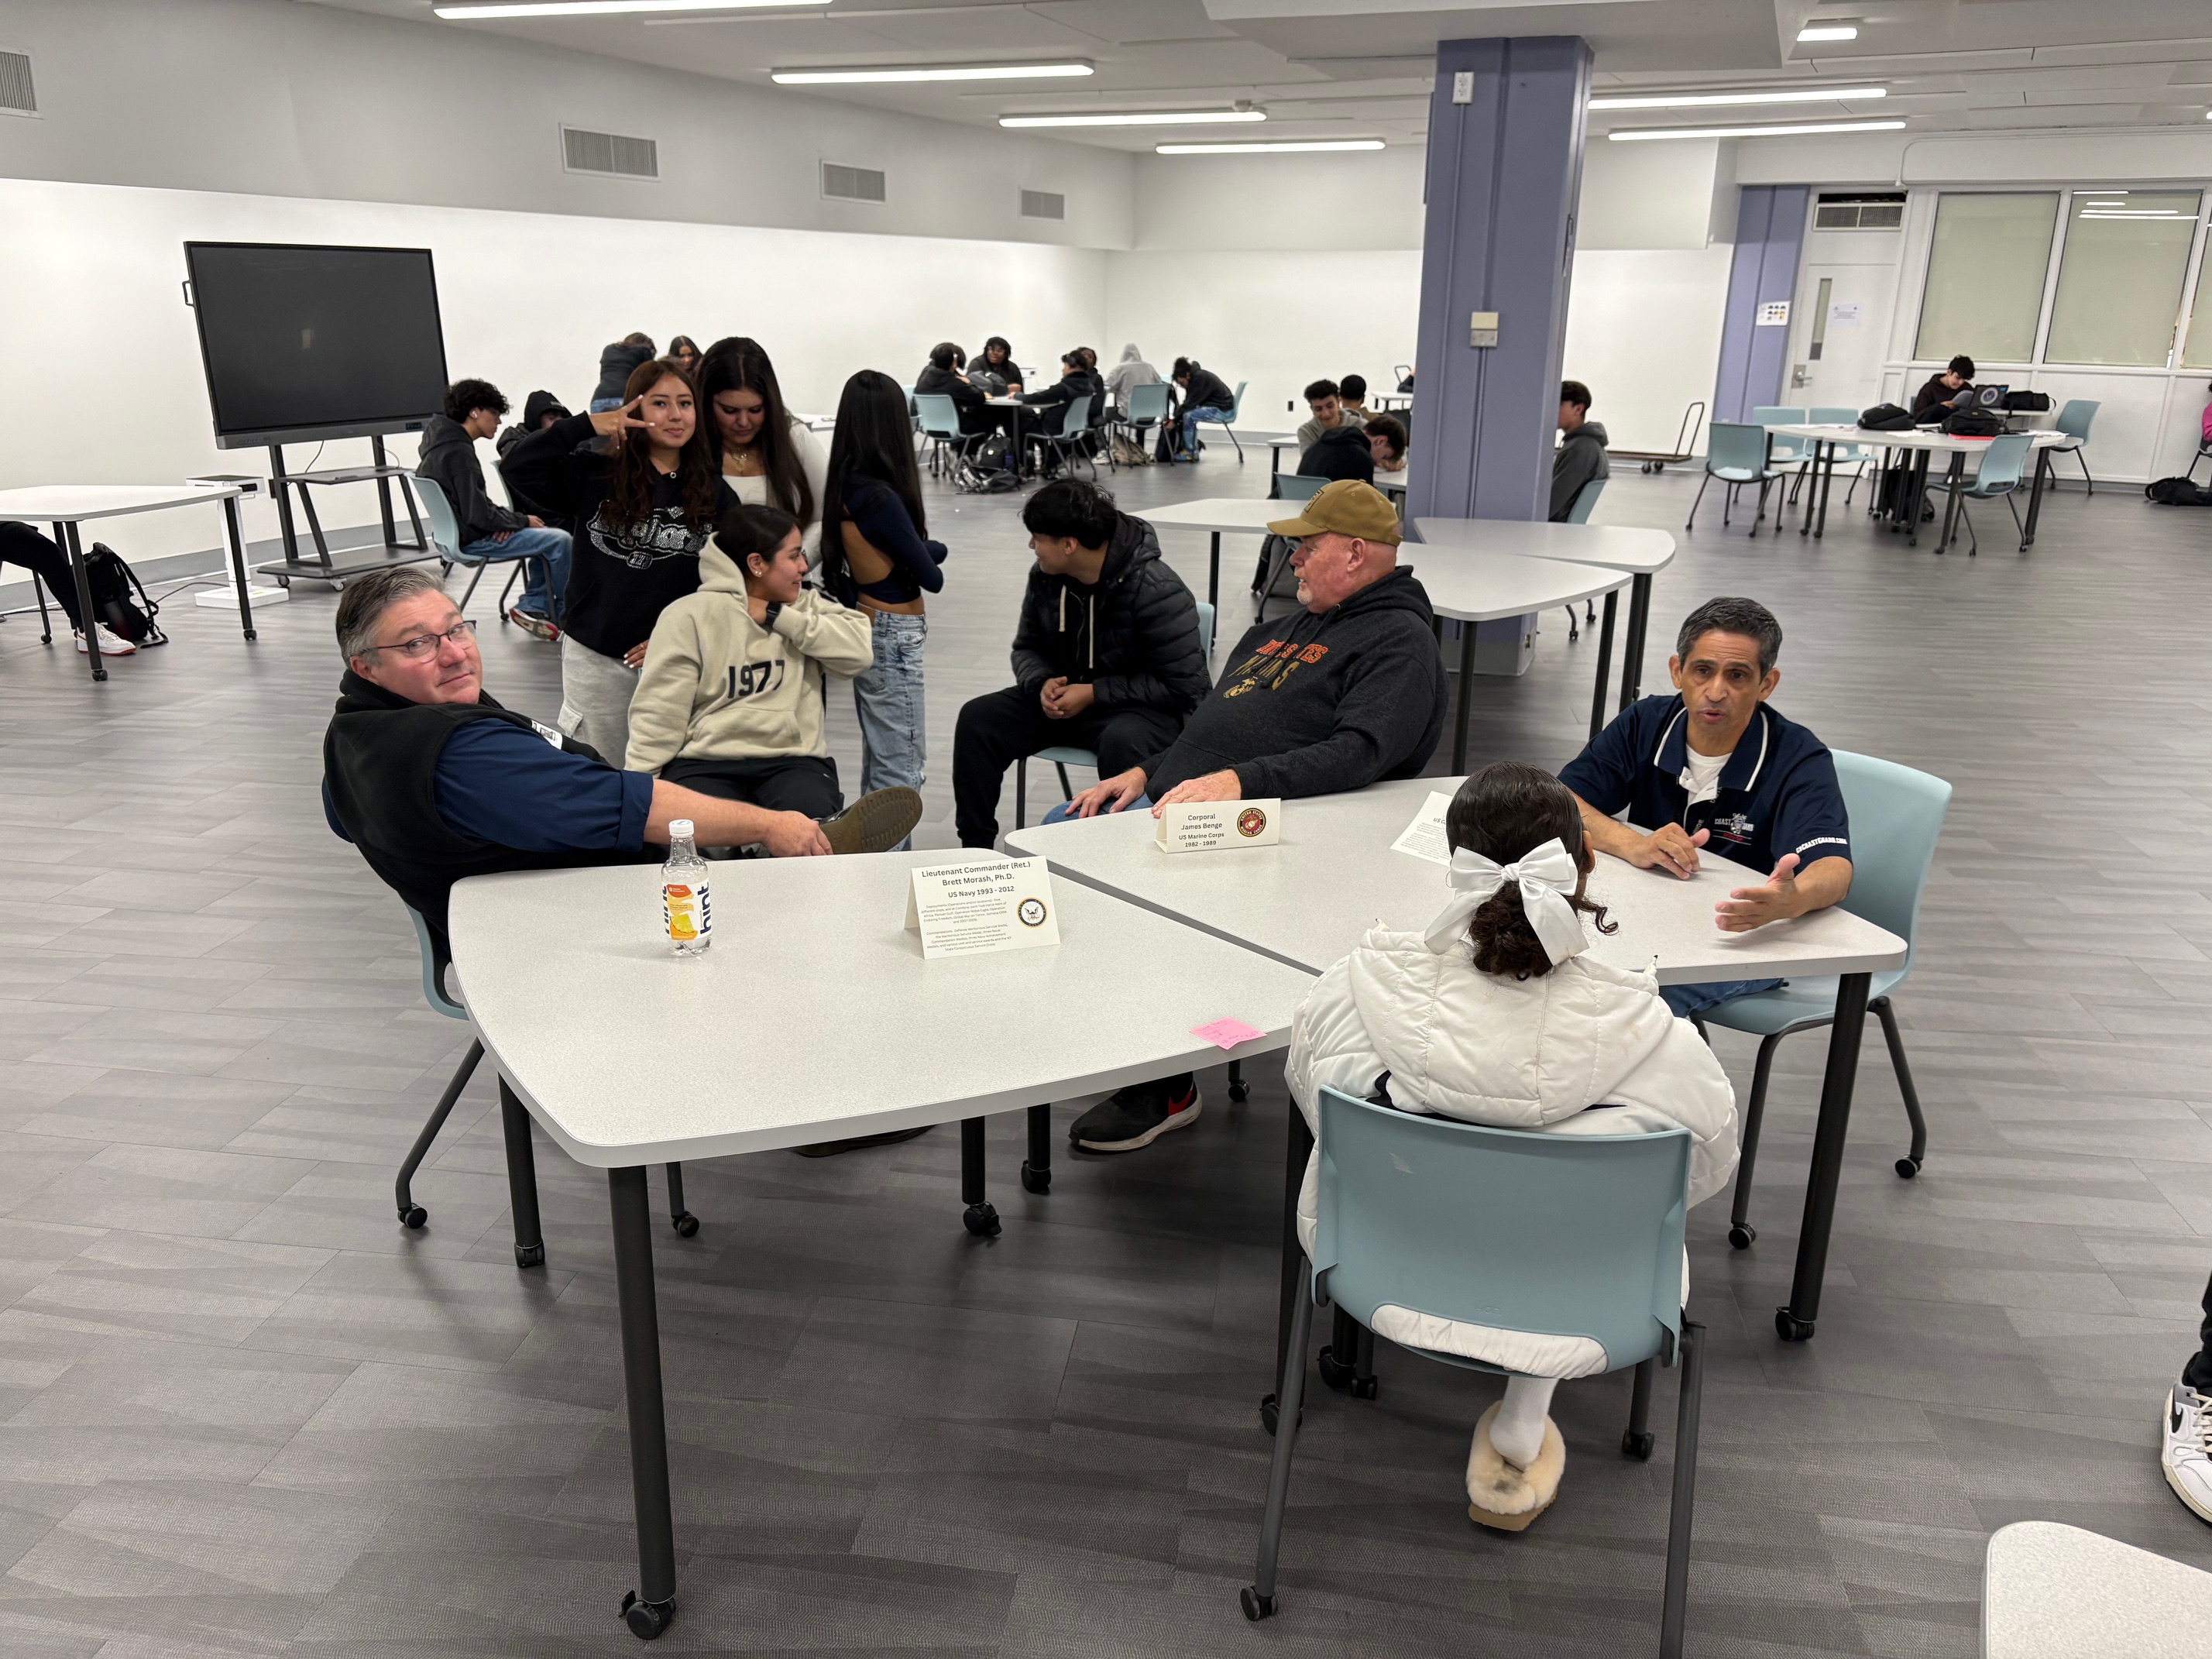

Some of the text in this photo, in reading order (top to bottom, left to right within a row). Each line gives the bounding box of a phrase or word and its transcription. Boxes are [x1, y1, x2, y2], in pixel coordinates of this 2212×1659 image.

[922, 861, 1031, 878] Lieutenant Commander (Ret.)
[963, 875, 993, 884] Morash,
[697, 881, 712, 935] hint
